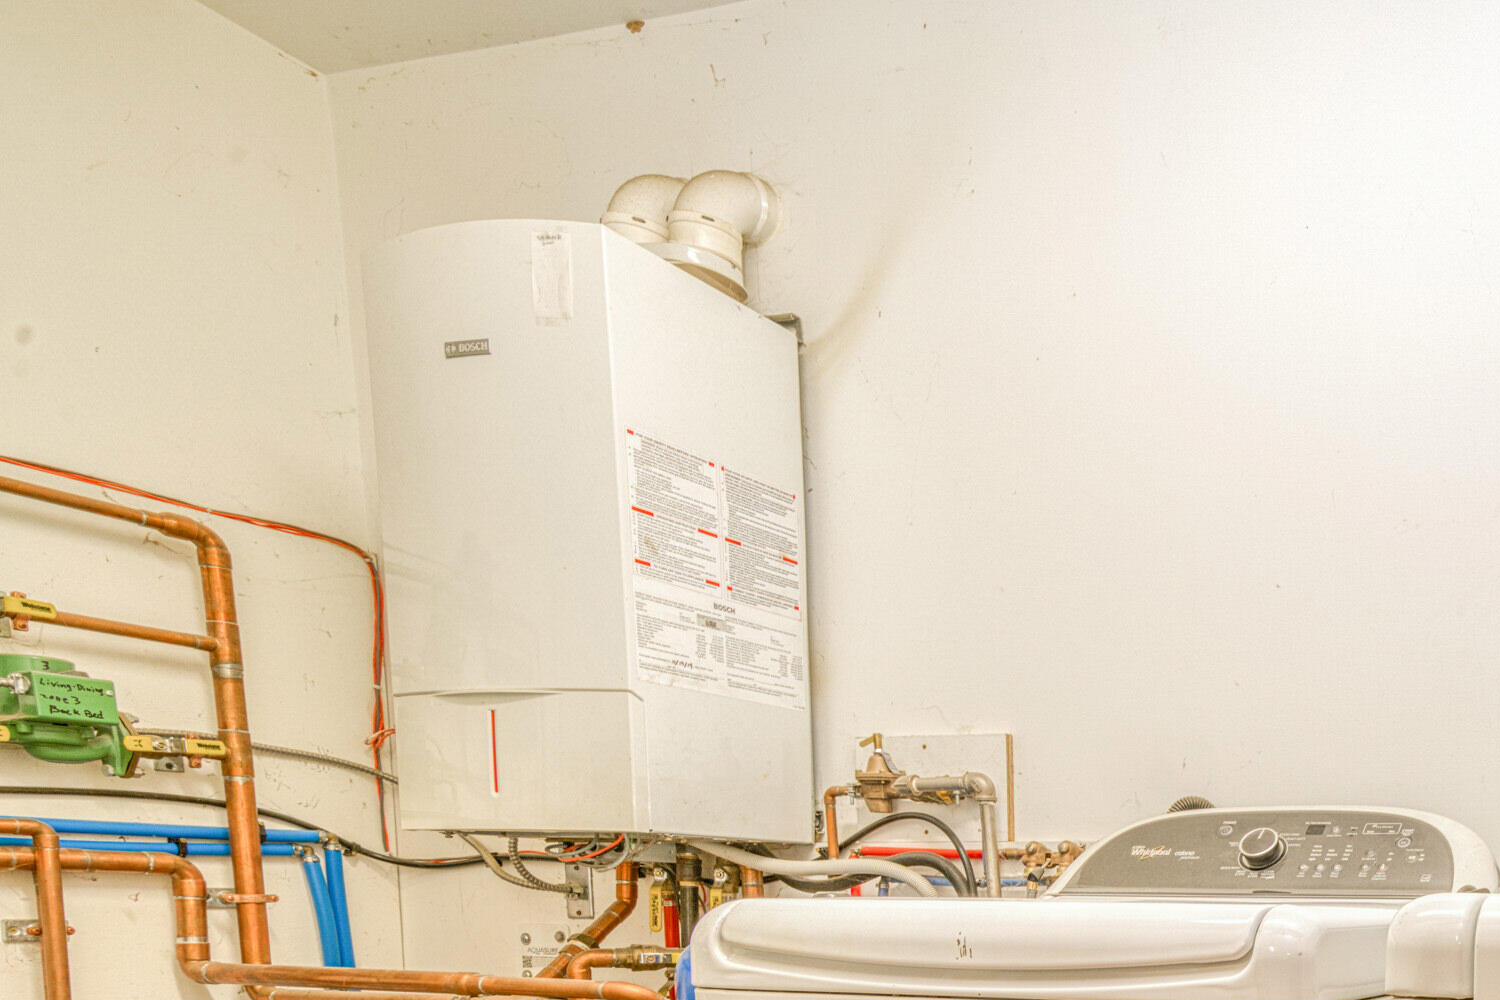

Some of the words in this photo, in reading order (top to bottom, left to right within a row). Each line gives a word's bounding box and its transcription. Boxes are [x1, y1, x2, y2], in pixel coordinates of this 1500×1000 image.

[459, 341, 488, 353] BOSCH
[41, 660, 49, 671] 3
[1131, 847, 1172, 859] Whirlpool
